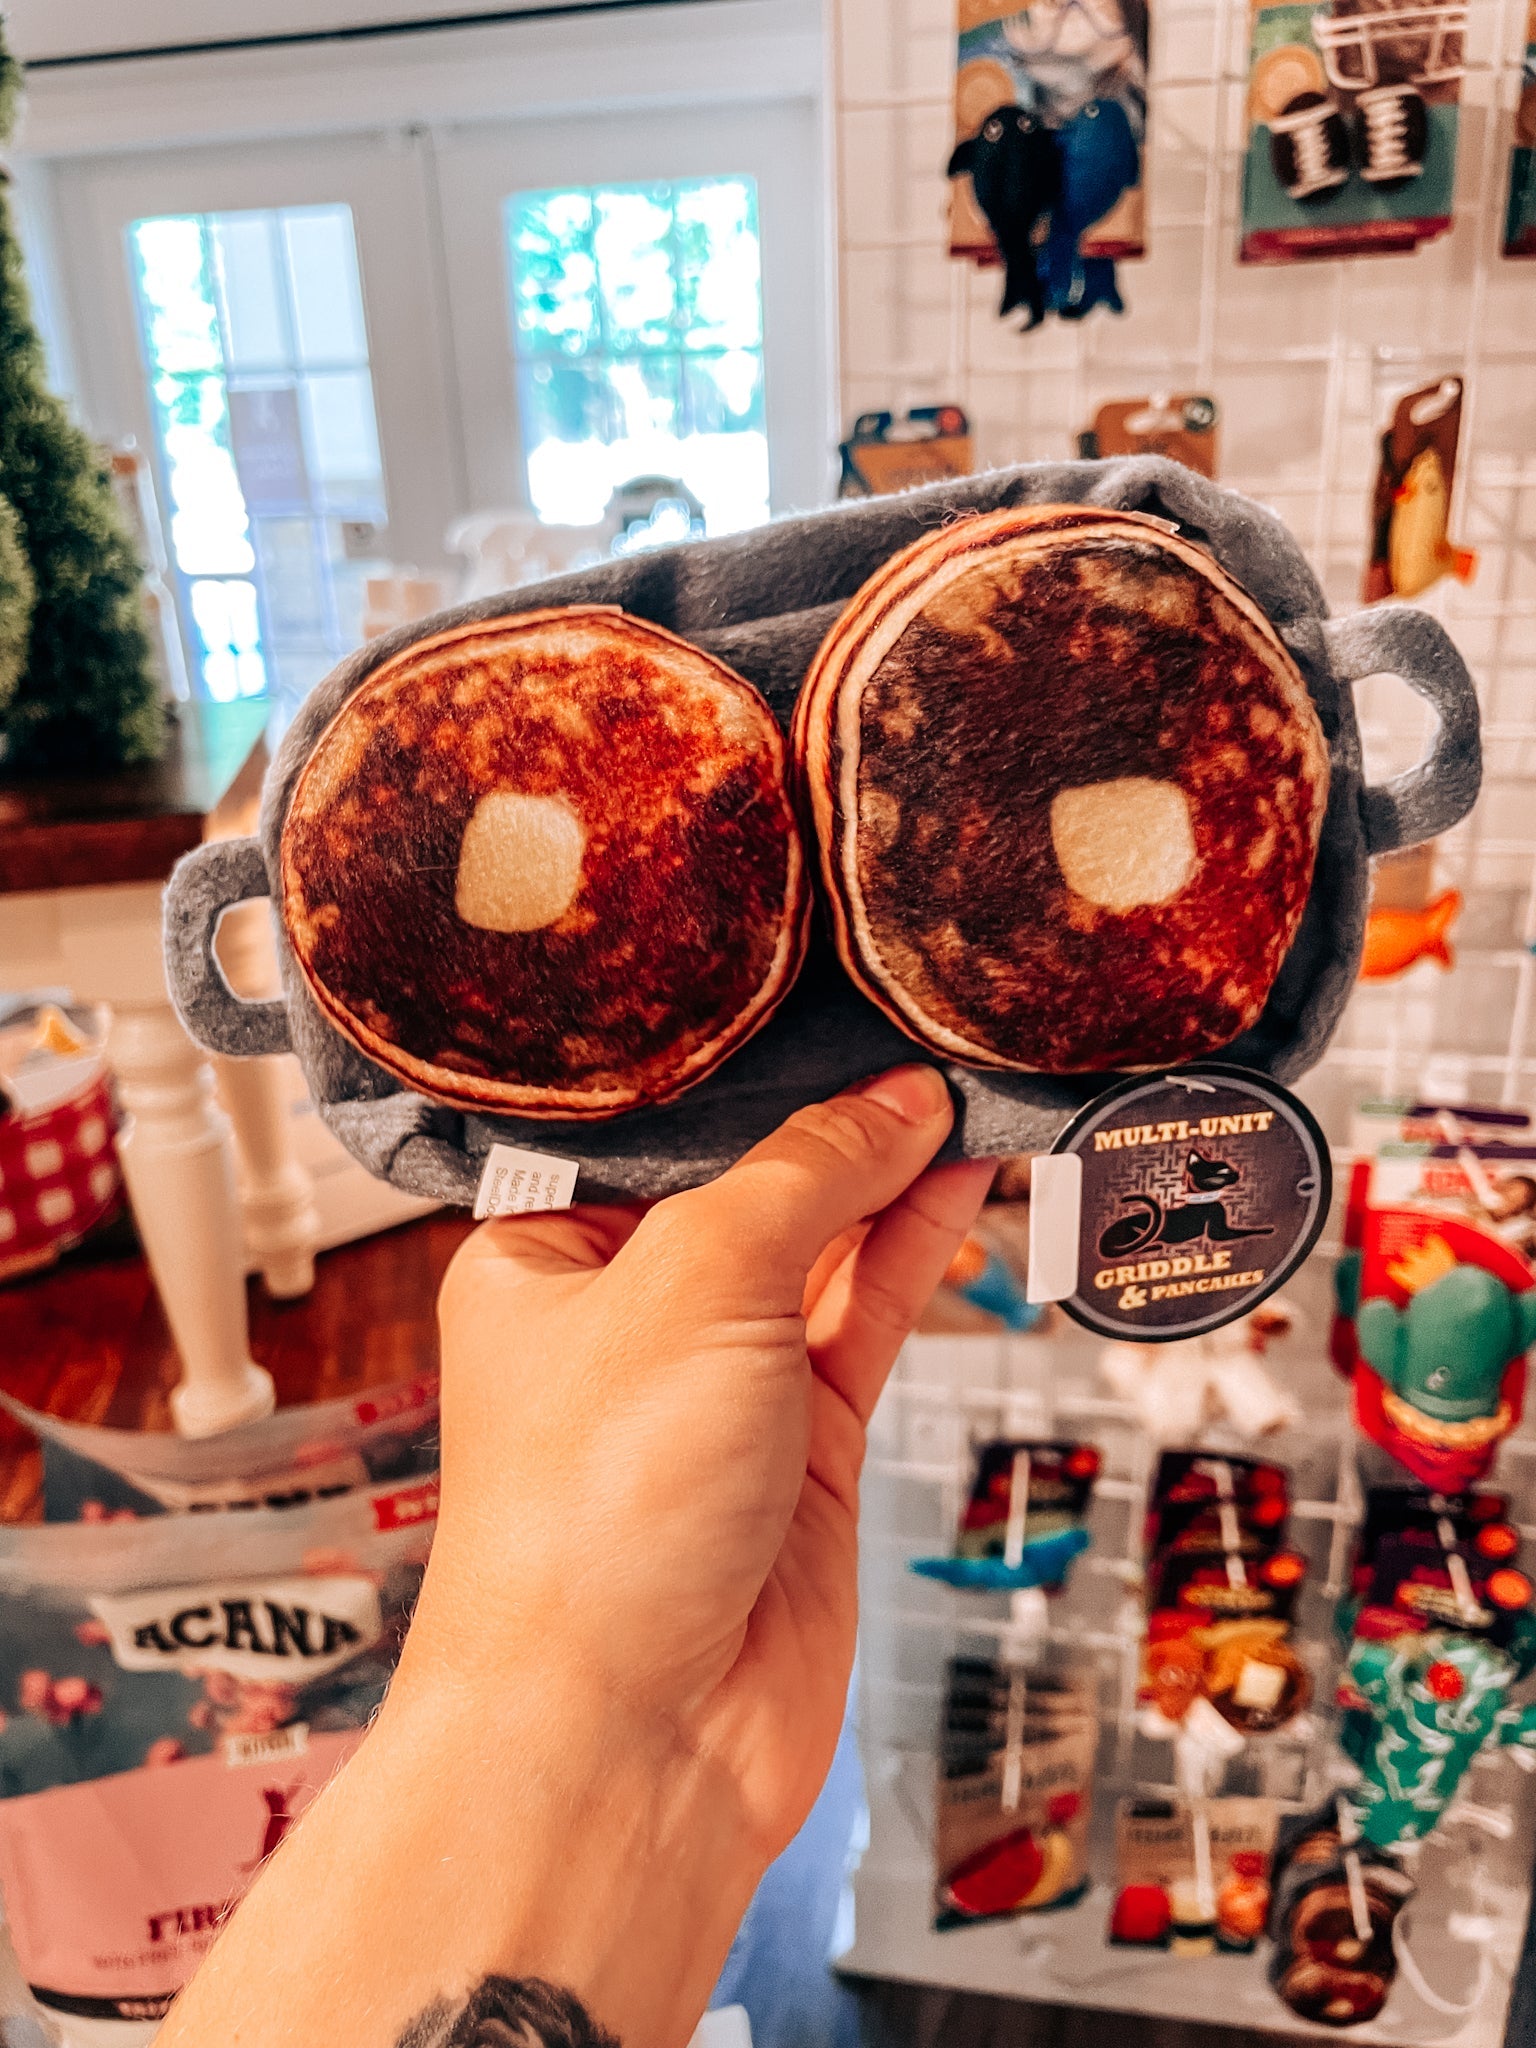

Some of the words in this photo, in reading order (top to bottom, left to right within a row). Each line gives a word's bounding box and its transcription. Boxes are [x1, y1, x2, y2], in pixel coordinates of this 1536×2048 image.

[1094, 1111, 1275, 1152] MULTI-UNIT
[484, 1167, 509, 1219] SteelDo
[508, 1168, 527, 1202] Made
[528, 1171, 542, 1194] and
[544, 1174, 560, 1209] super
[1094, 1250, 1232, 1290] GRIDDLE
[1117, 1285, 1148, 1311] &
[1151, 1269, 1265, 1301] PANCAKES
[134, 1600, 363, 1657] ACANA
